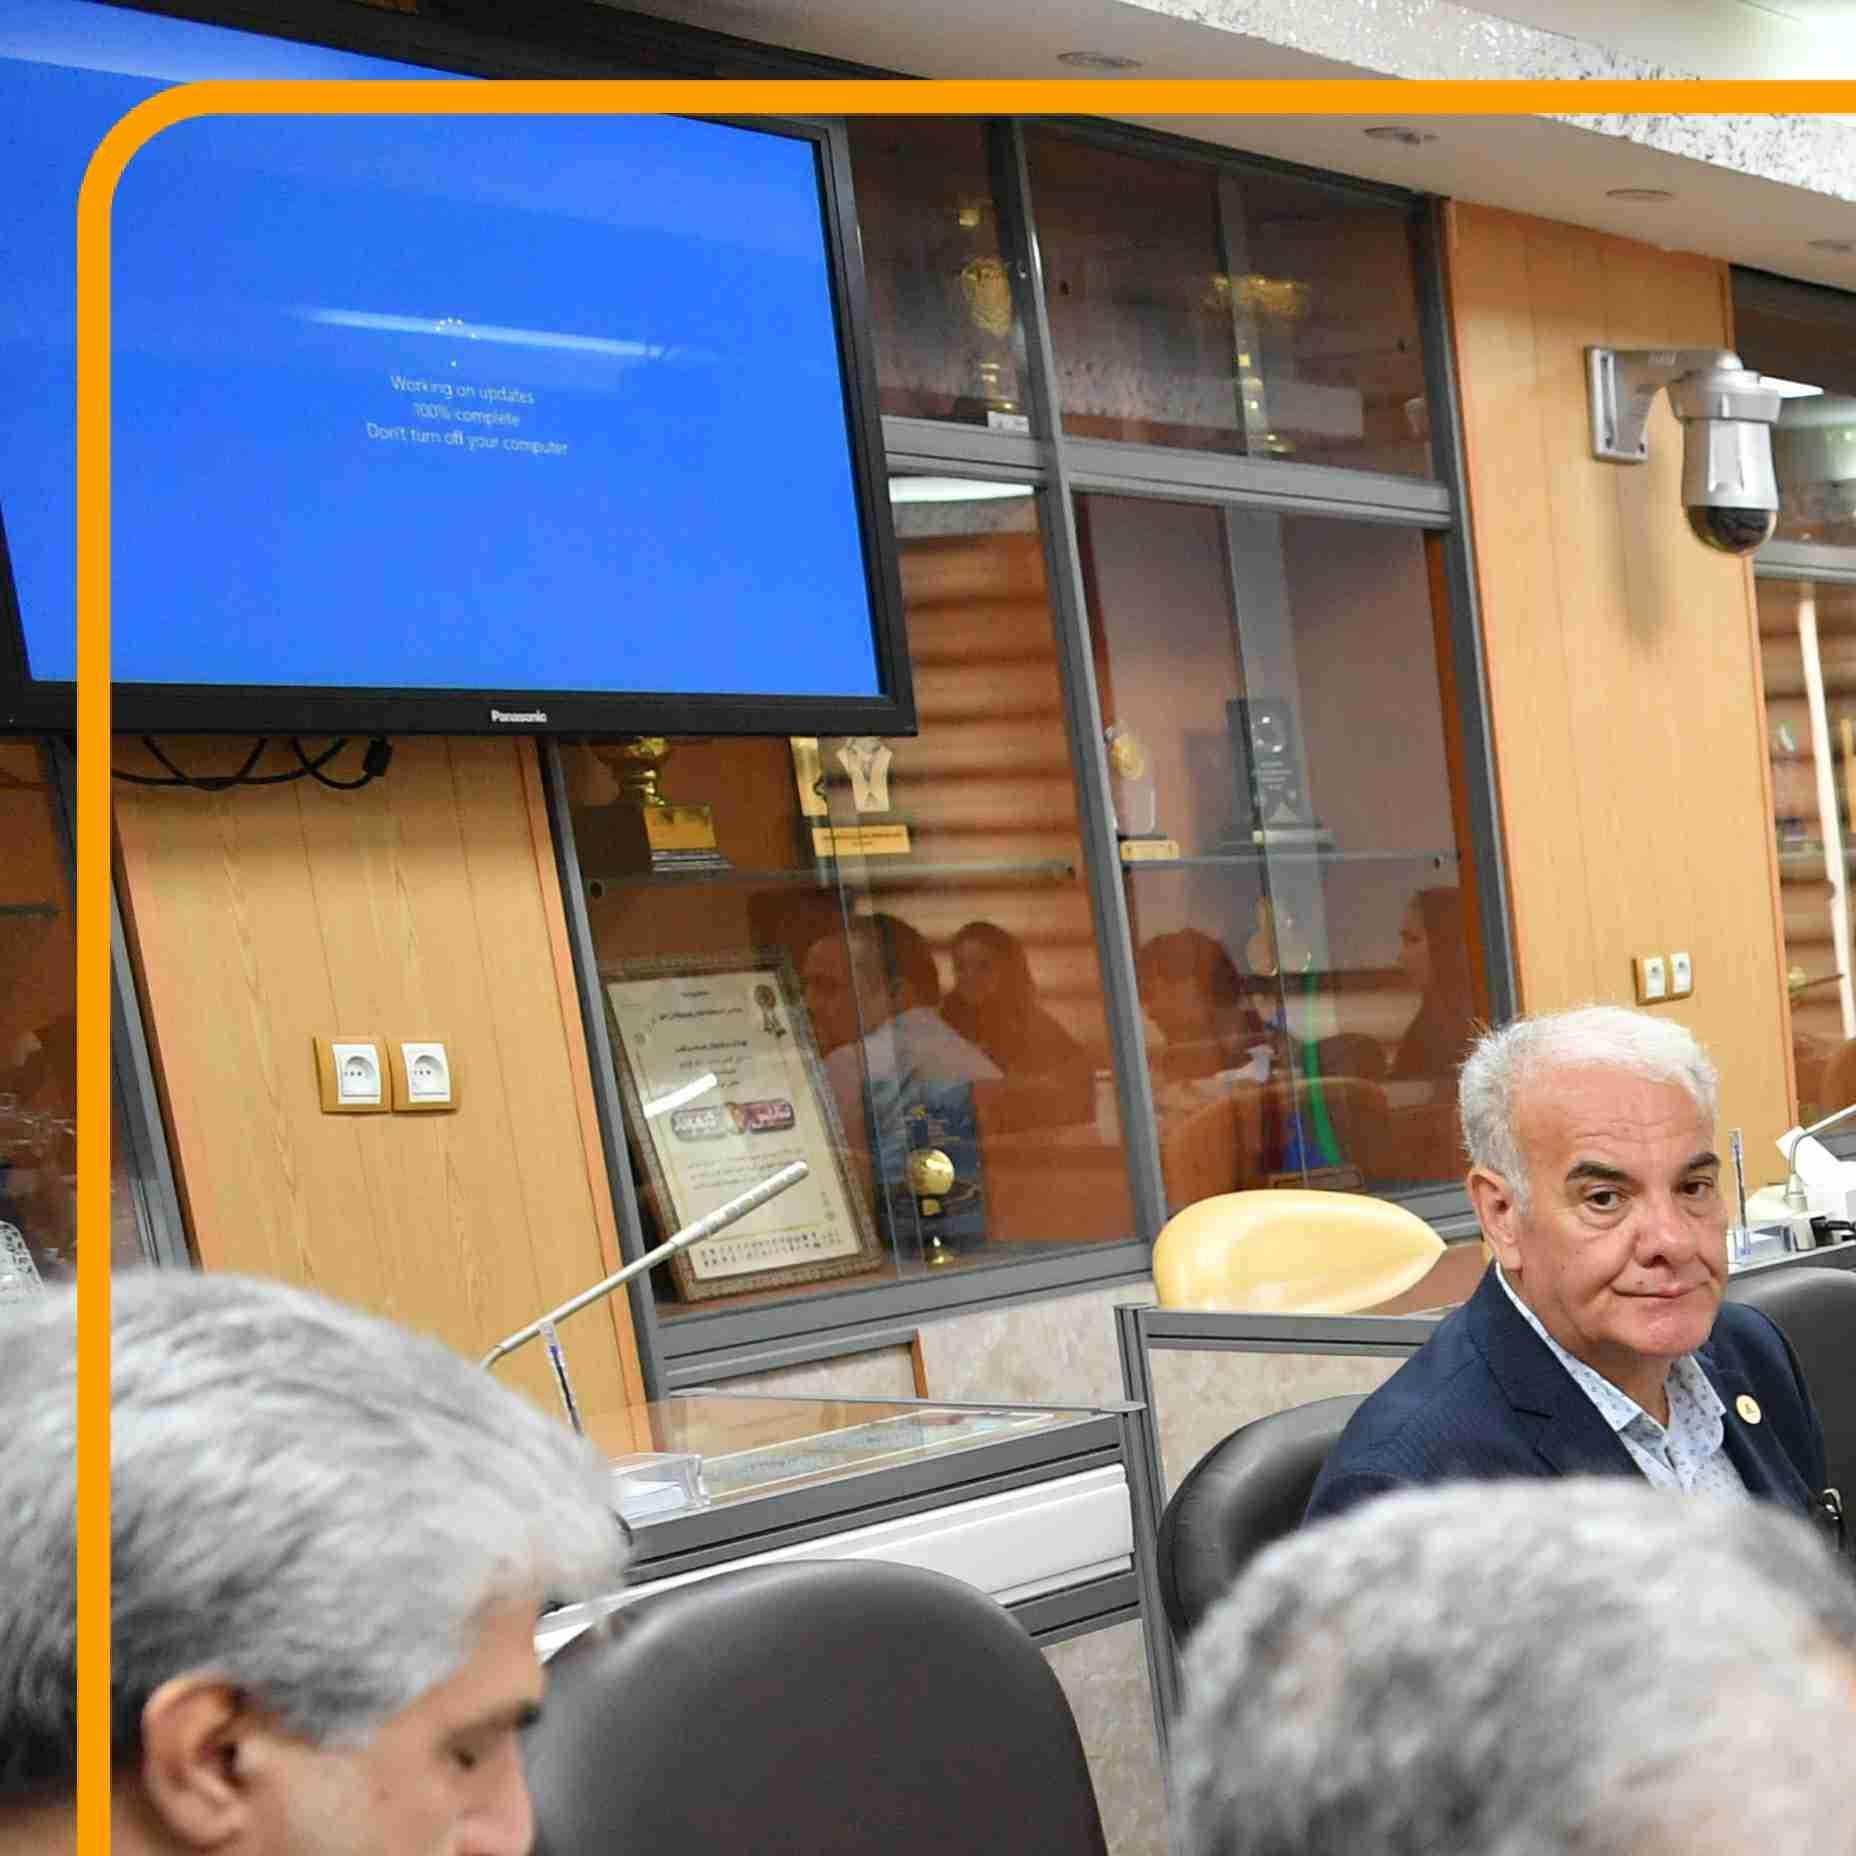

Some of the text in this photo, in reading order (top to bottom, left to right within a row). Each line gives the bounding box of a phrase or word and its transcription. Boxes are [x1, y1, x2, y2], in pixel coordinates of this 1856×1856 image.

[389, 375, 536, 405] Working on updates
[412, 402, 520, 427] 100% complete
[366, 421, 568, 457] Don't turn off your computer
